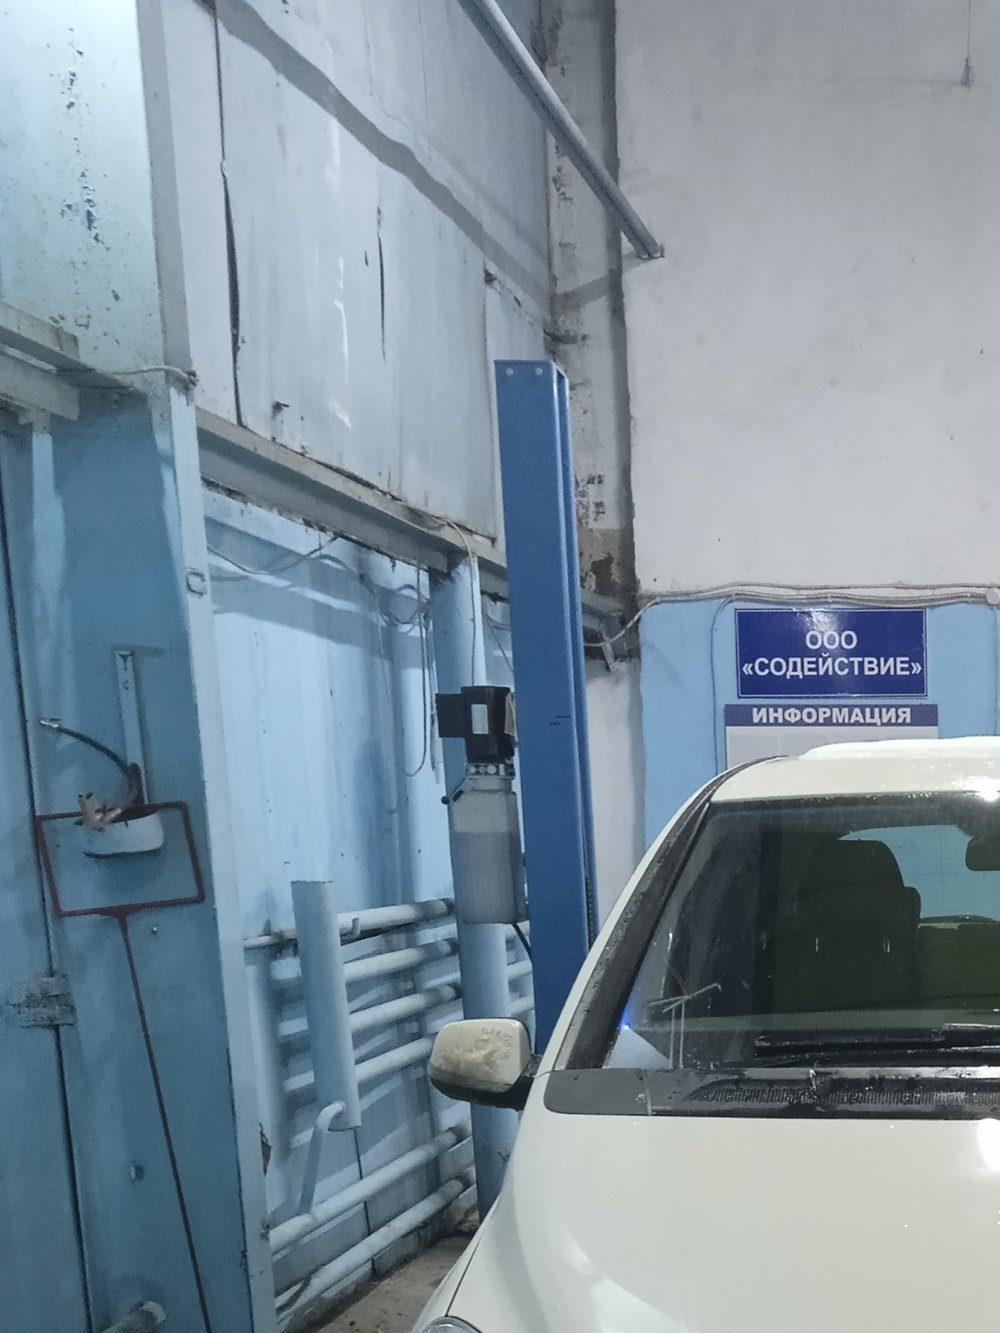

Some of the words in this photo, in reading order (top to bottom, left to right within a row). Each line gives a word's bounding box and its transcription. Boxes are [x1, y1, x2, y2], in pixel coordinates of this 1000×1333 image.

[805, 630, 858, 650] ООО
[741, 653, 922, 679] «СОДЕЙСТВИЕ»
[752, 707, 912, 726] ИНФОРМАЦИЯ
